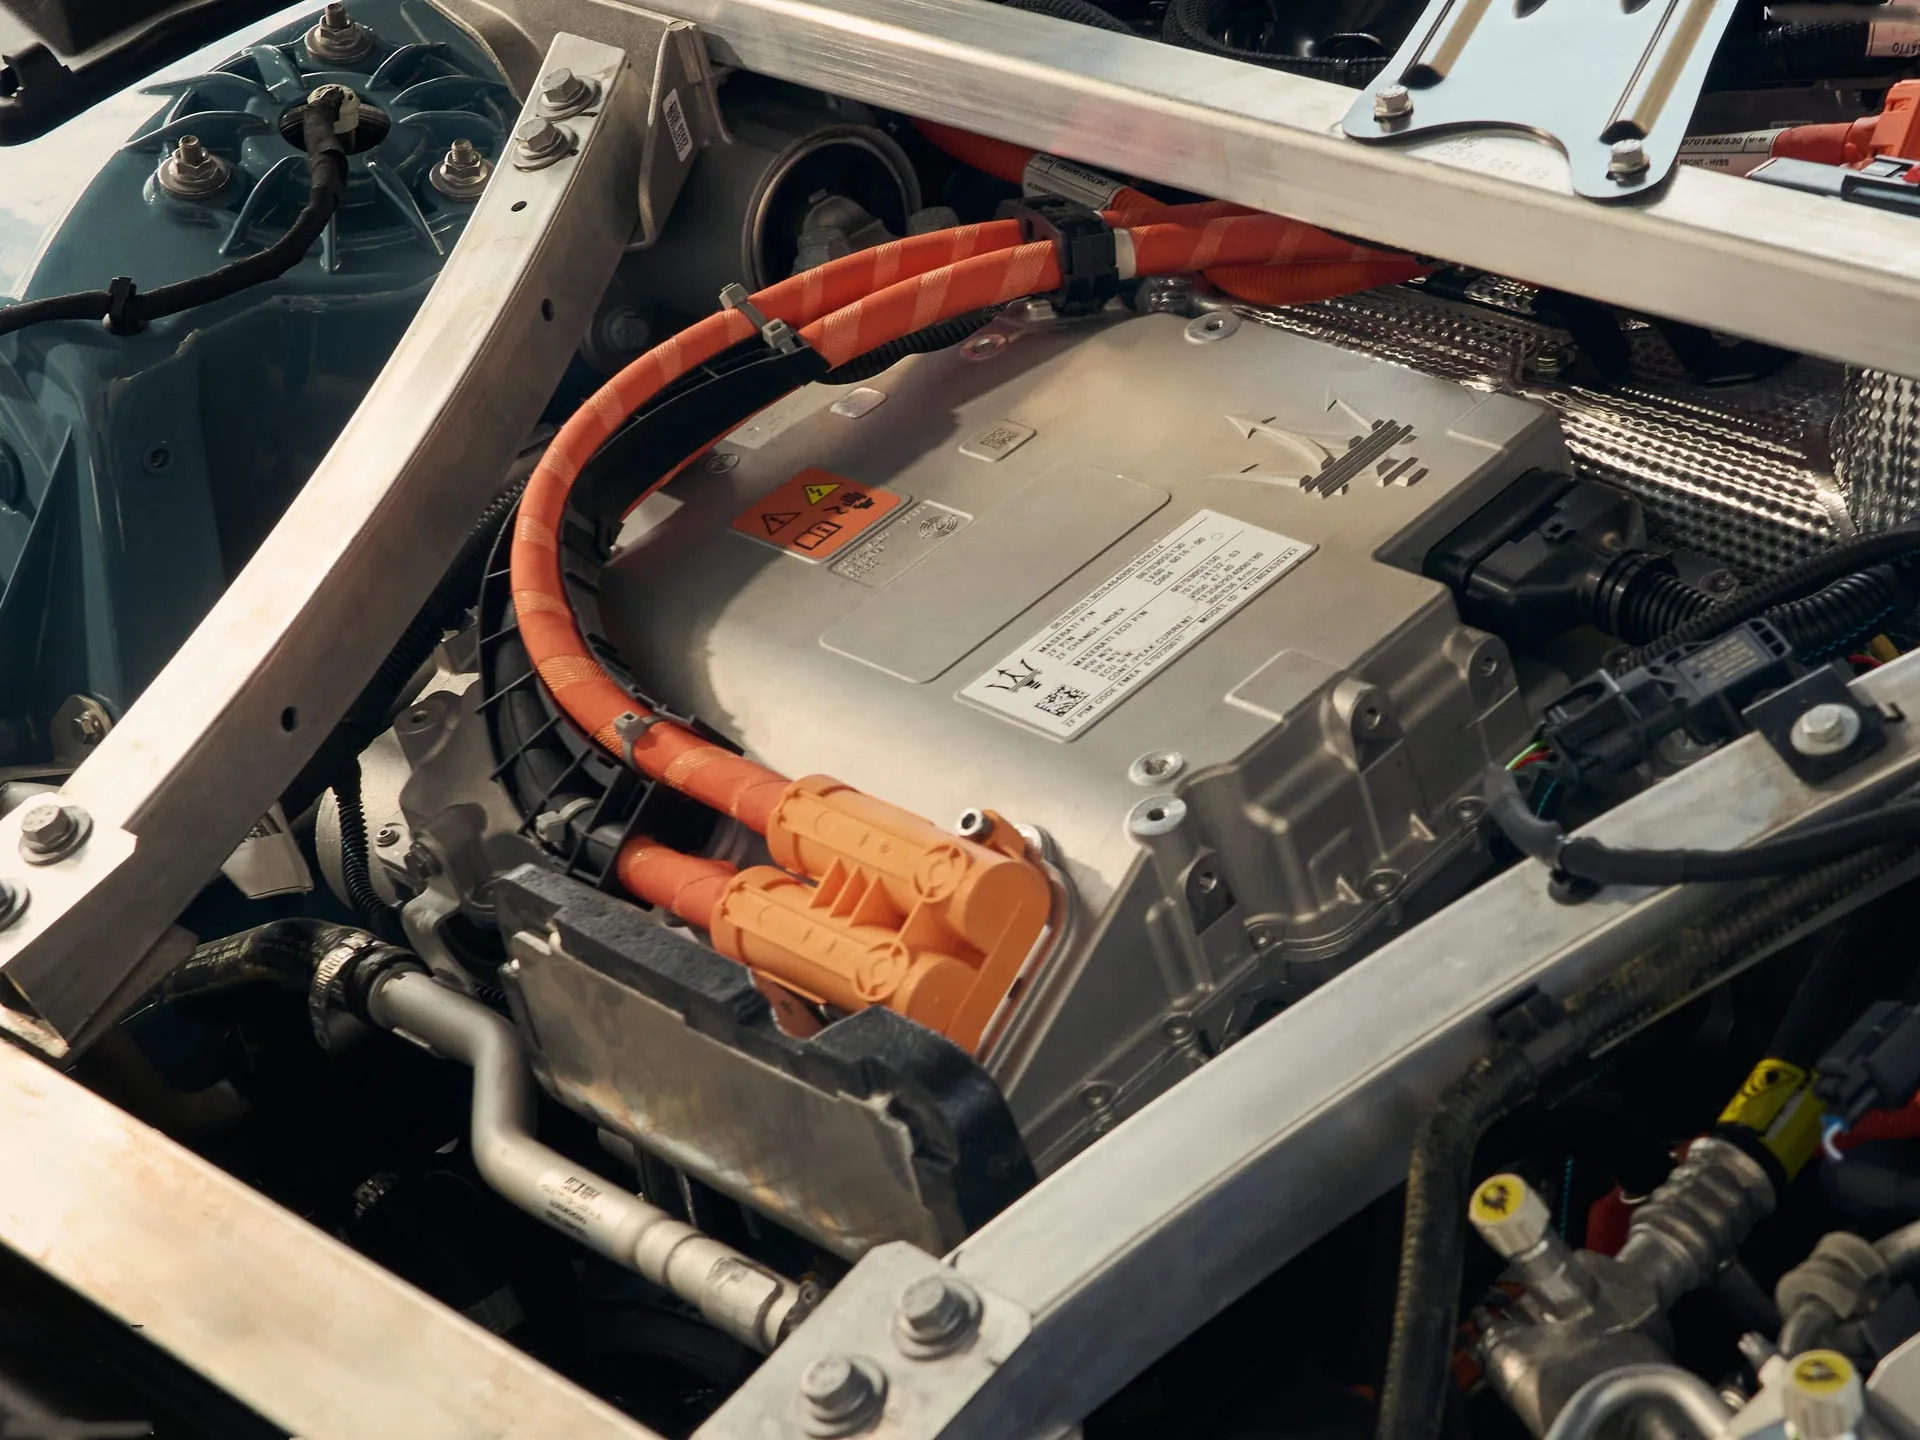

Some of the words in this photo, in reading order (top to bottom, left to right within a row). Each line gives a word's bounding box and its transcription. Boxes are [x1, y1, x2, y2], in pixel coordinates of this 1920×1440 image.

[1038, 623, 1080, 653] MASERATI
[1080, 611, 1096, 622] P/N
[1055, 652, 1067, 660] ZF
[1067, 627, 1100, 651] CHANGE
[1101, 607, 1126, 625] INDEX
[1073, 636, 1114, 667] MASERATI
[1114, 623, 1132, 635] ECU
[1132, 611, 1148, 622] P/N
[1155, 616, 1194, 644] CURRENT
[1047, 649, 1059, 657] ZF
[1059, 636, 1075, 647] P/N
[1065, 719, 1077, 727] ZF
[1077, 705, 1095, 718] PIM
[1095, 688, 1117, 704] CODE
[1117, 669, 1141, 687] EMEA
[1199, 603, 1227, 624] MODEL
[1081, 659, 1098, 671] HW
[1090, 663, 1106, 674] SW
[1099, 665, 1117, 677] ECU
[1116, 652, 1133, 664] S/N
